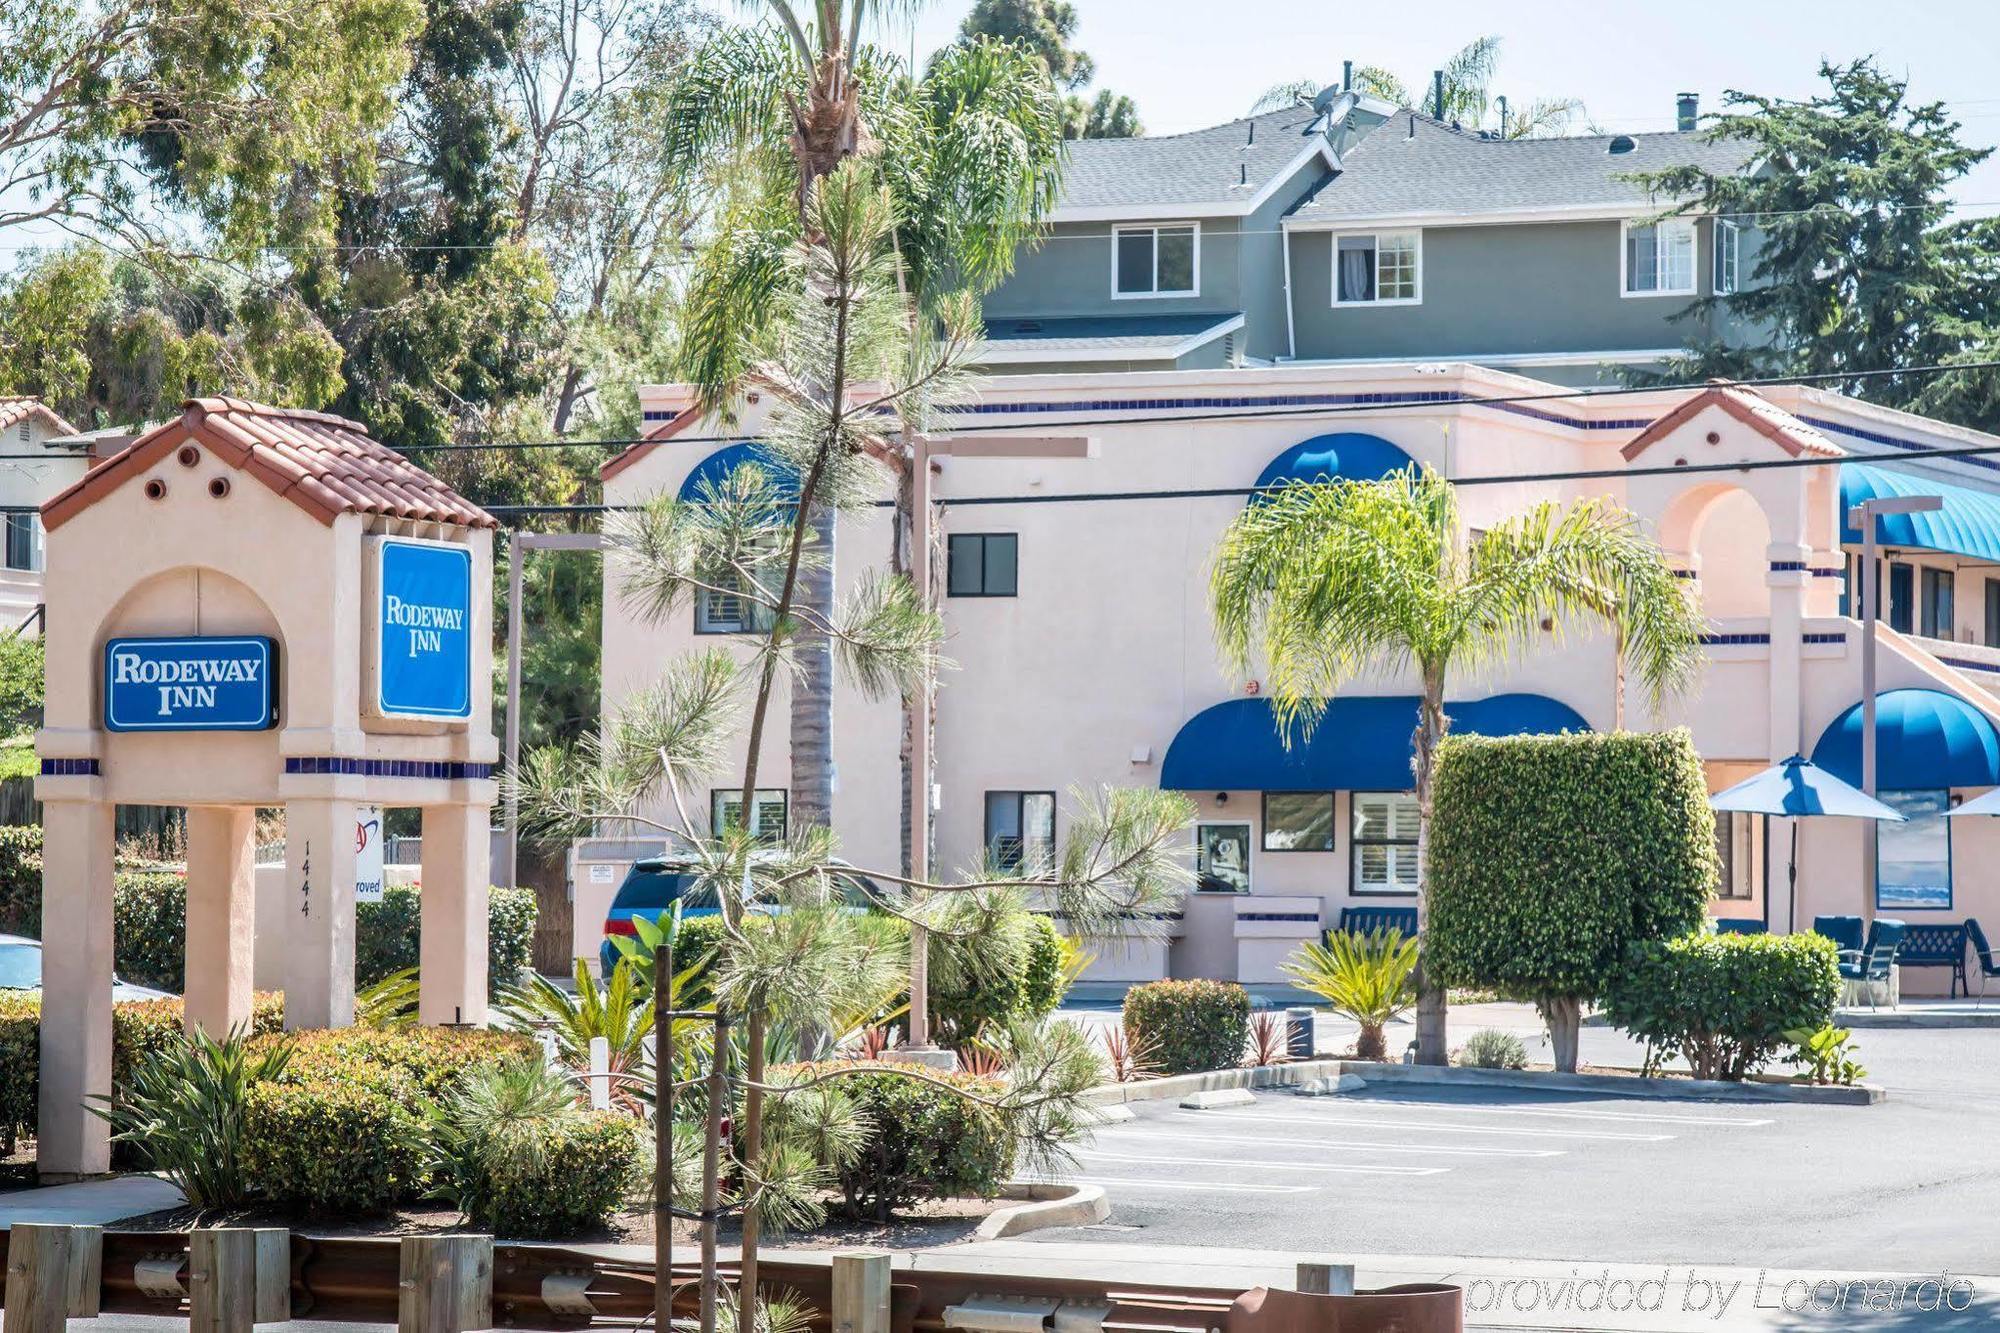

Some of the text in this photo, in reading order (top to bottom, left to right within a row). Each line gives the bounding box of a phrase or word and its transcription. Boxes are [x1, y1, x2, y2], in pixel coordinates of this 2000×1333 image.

[386, 595, 463, 630] RODEWAY
[409, 629, 441, 658] INN
[114, 653, 261, 684] RODEWAY
[158, 685, 217, 715] INN
[301, 839, 310, 917] 1444
